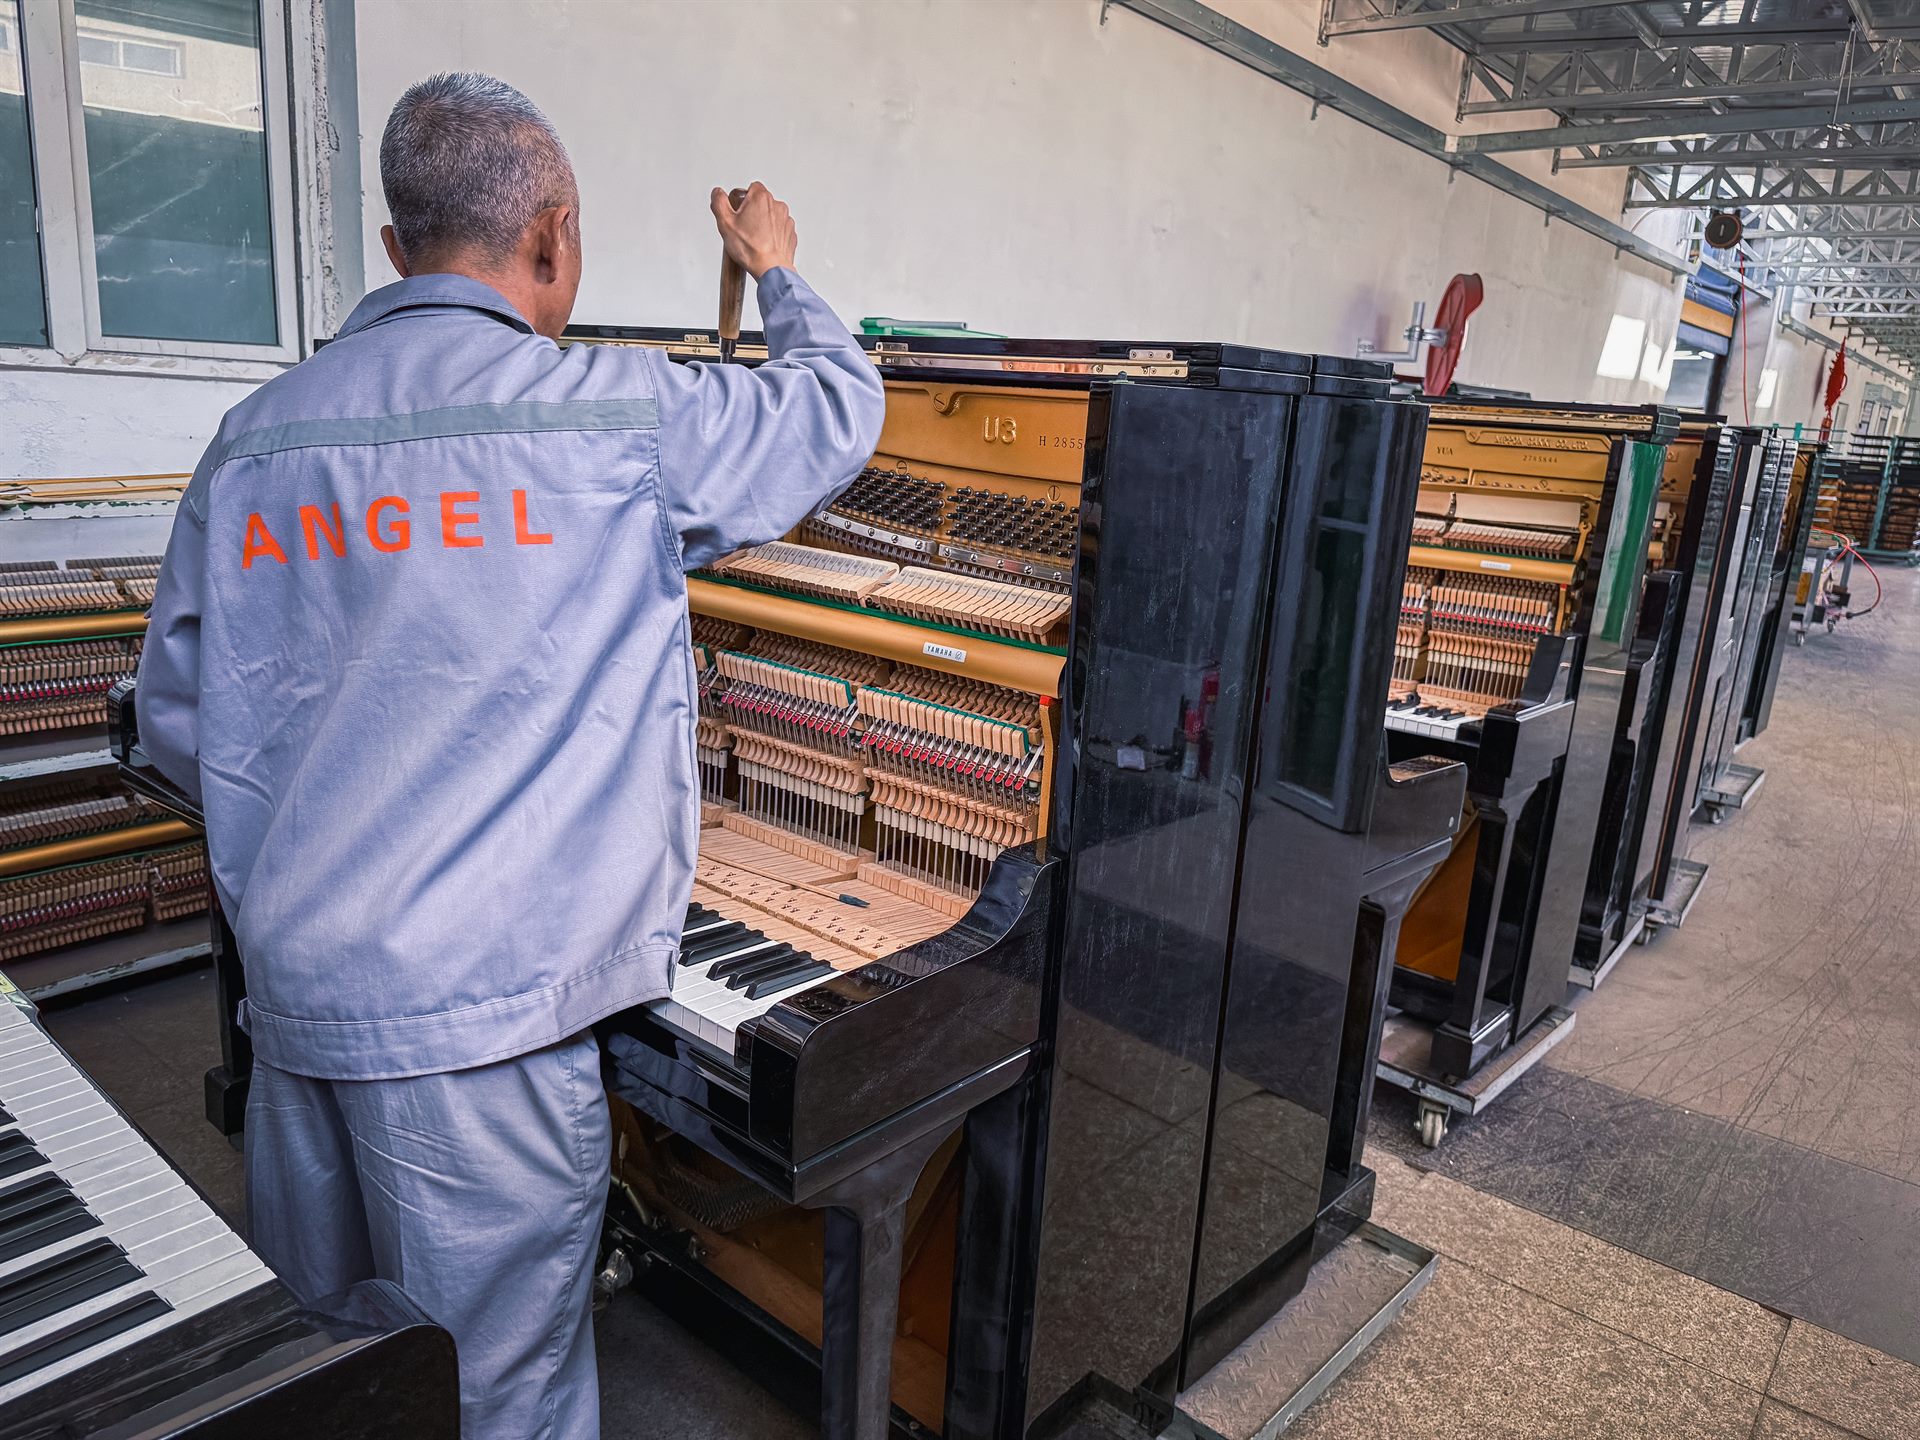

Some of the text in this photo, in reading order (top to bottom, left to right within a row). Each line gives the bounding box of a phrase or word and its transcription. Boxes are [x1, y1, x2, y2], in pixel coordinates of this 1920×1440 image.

[983, 416, 1016, 445] U3
[1039, 435, 1046, 446] H
[241, 489, 553, 569] ANGEL
[927, 645, 953, 657] YAMAHA
